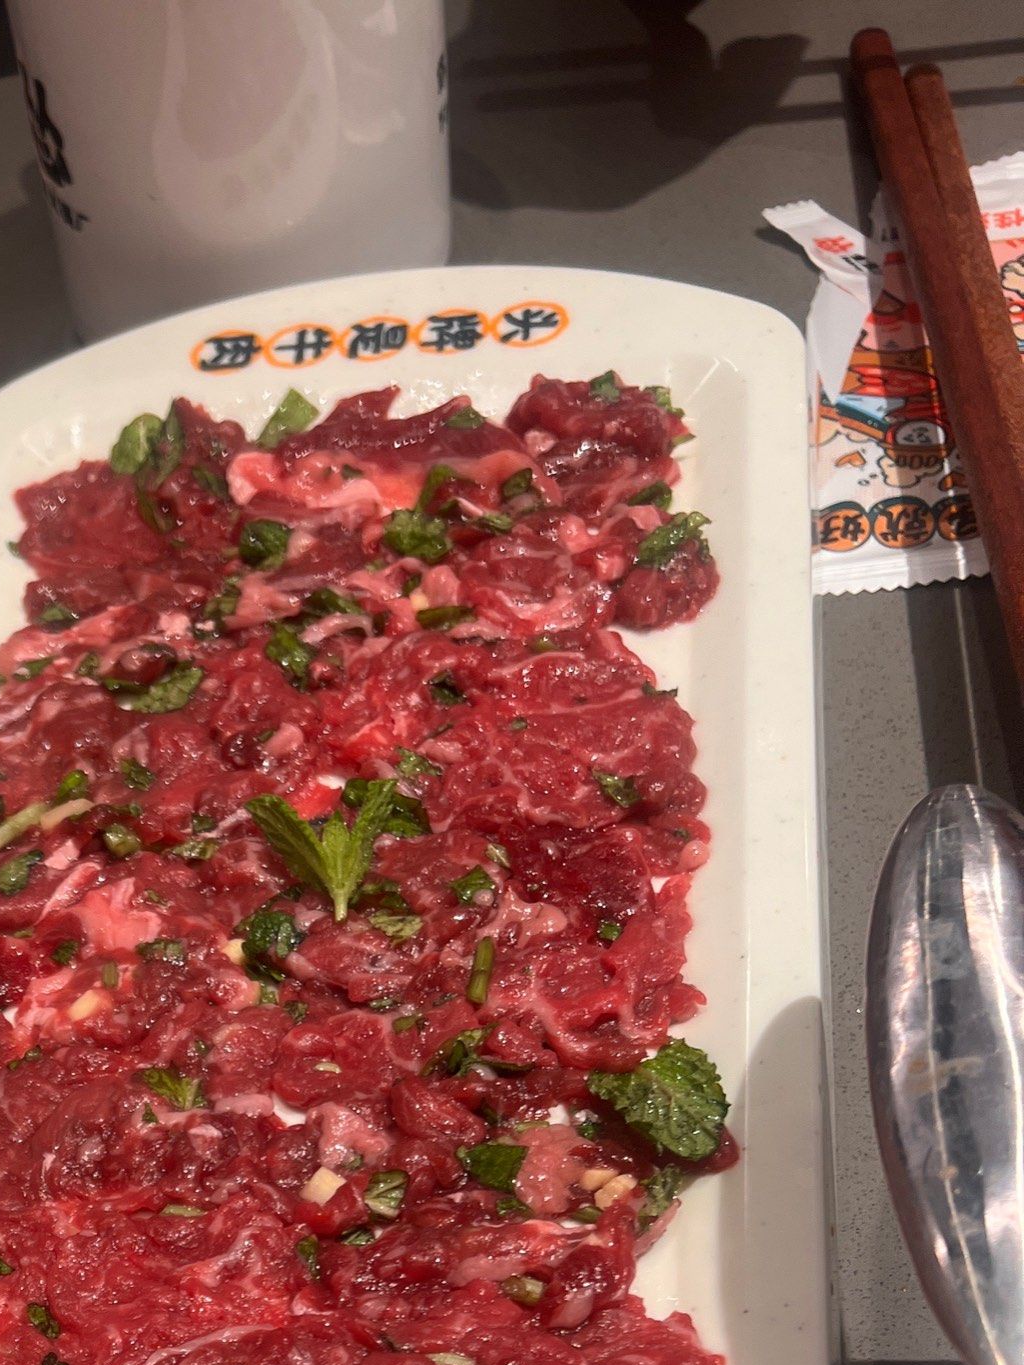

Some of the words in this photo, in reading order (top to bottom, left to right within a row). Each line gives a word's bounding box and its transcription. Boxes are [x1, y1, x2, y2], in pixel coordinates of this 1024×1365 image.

[199, 307, 561, 372] 头牌是牛肉
